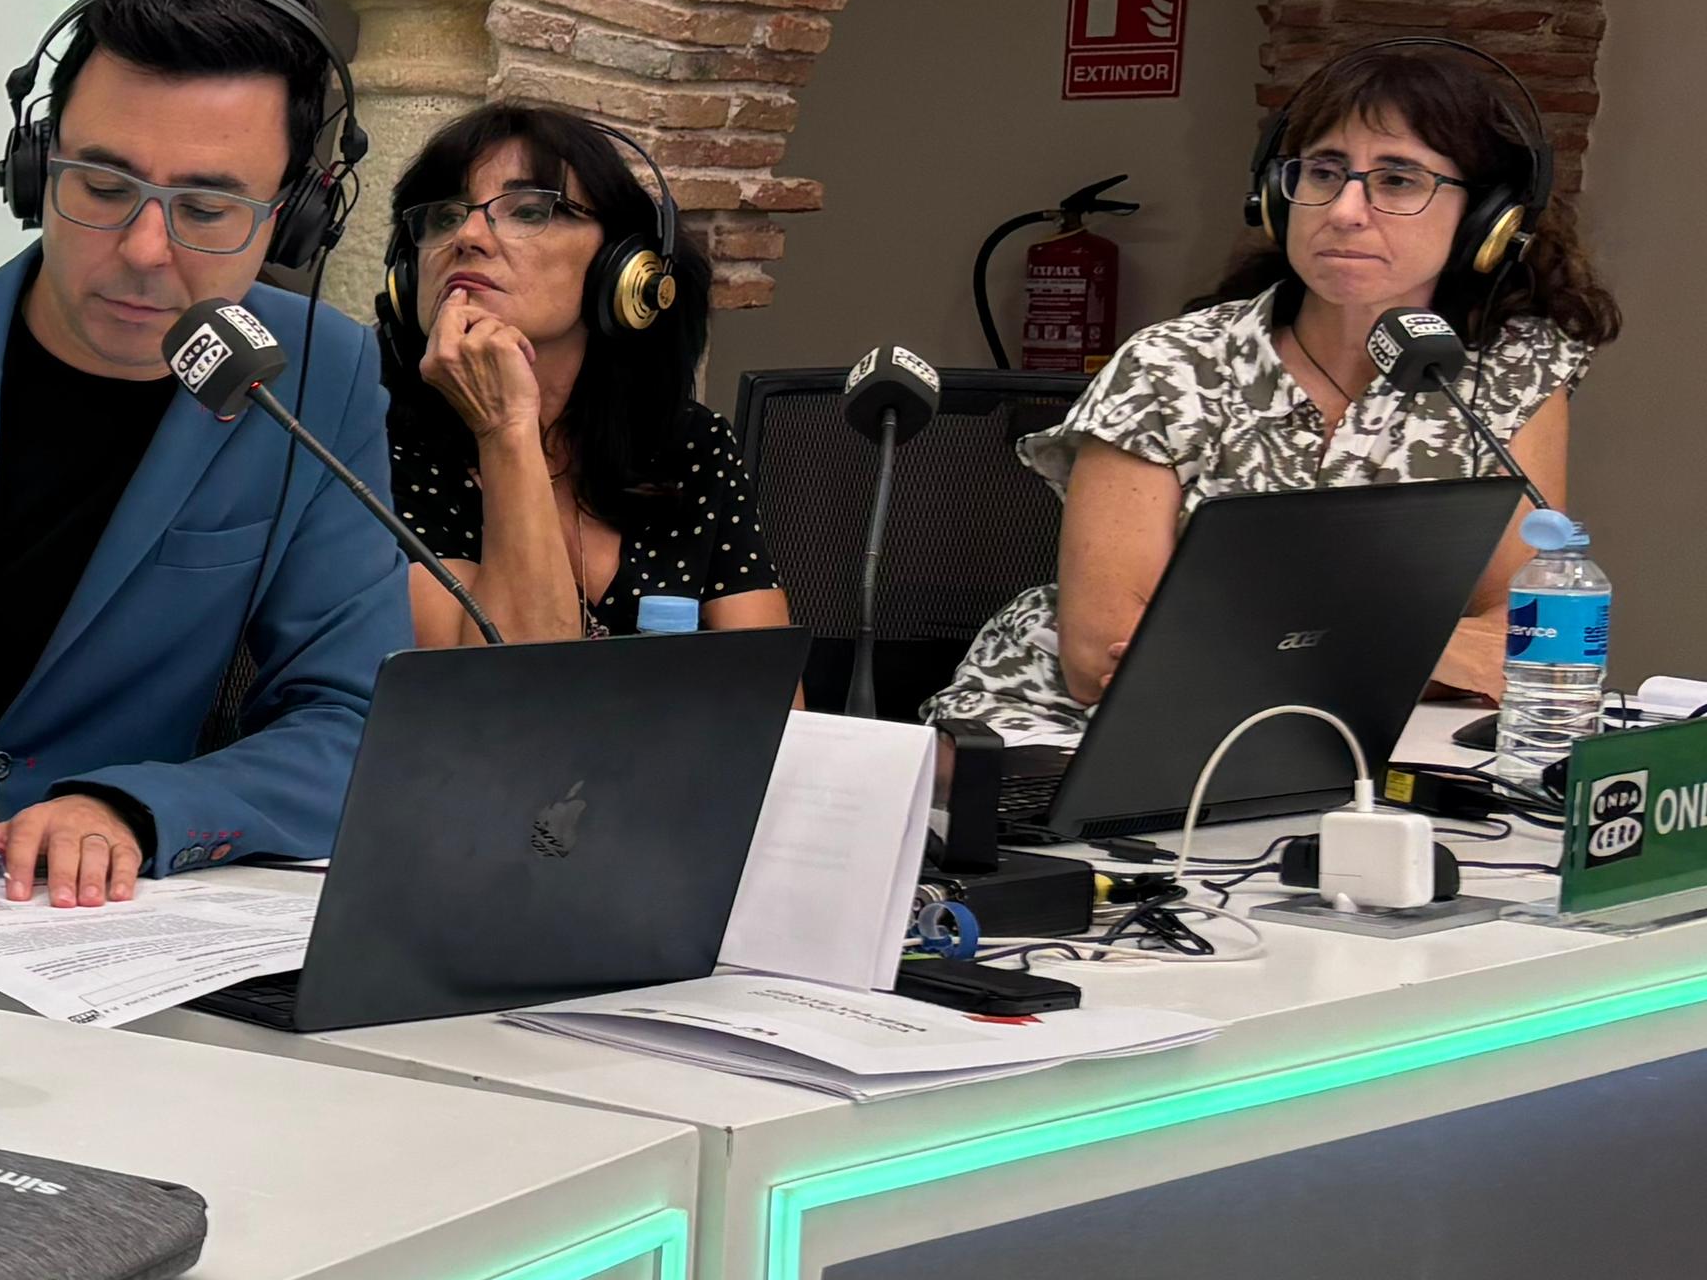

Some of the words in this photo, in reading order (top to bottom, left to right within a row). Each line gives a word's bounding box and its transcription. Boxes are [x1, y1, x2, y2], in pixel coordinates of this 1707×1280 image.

[1073, 63, 1170, 82] EXTINTOR
[178, 337, 210, 371] ONDA
[191, 349, 219, 379] CERO
[1277, 627, 1331, 651] acer
[1595, 789, 1639, 815] ONDA
